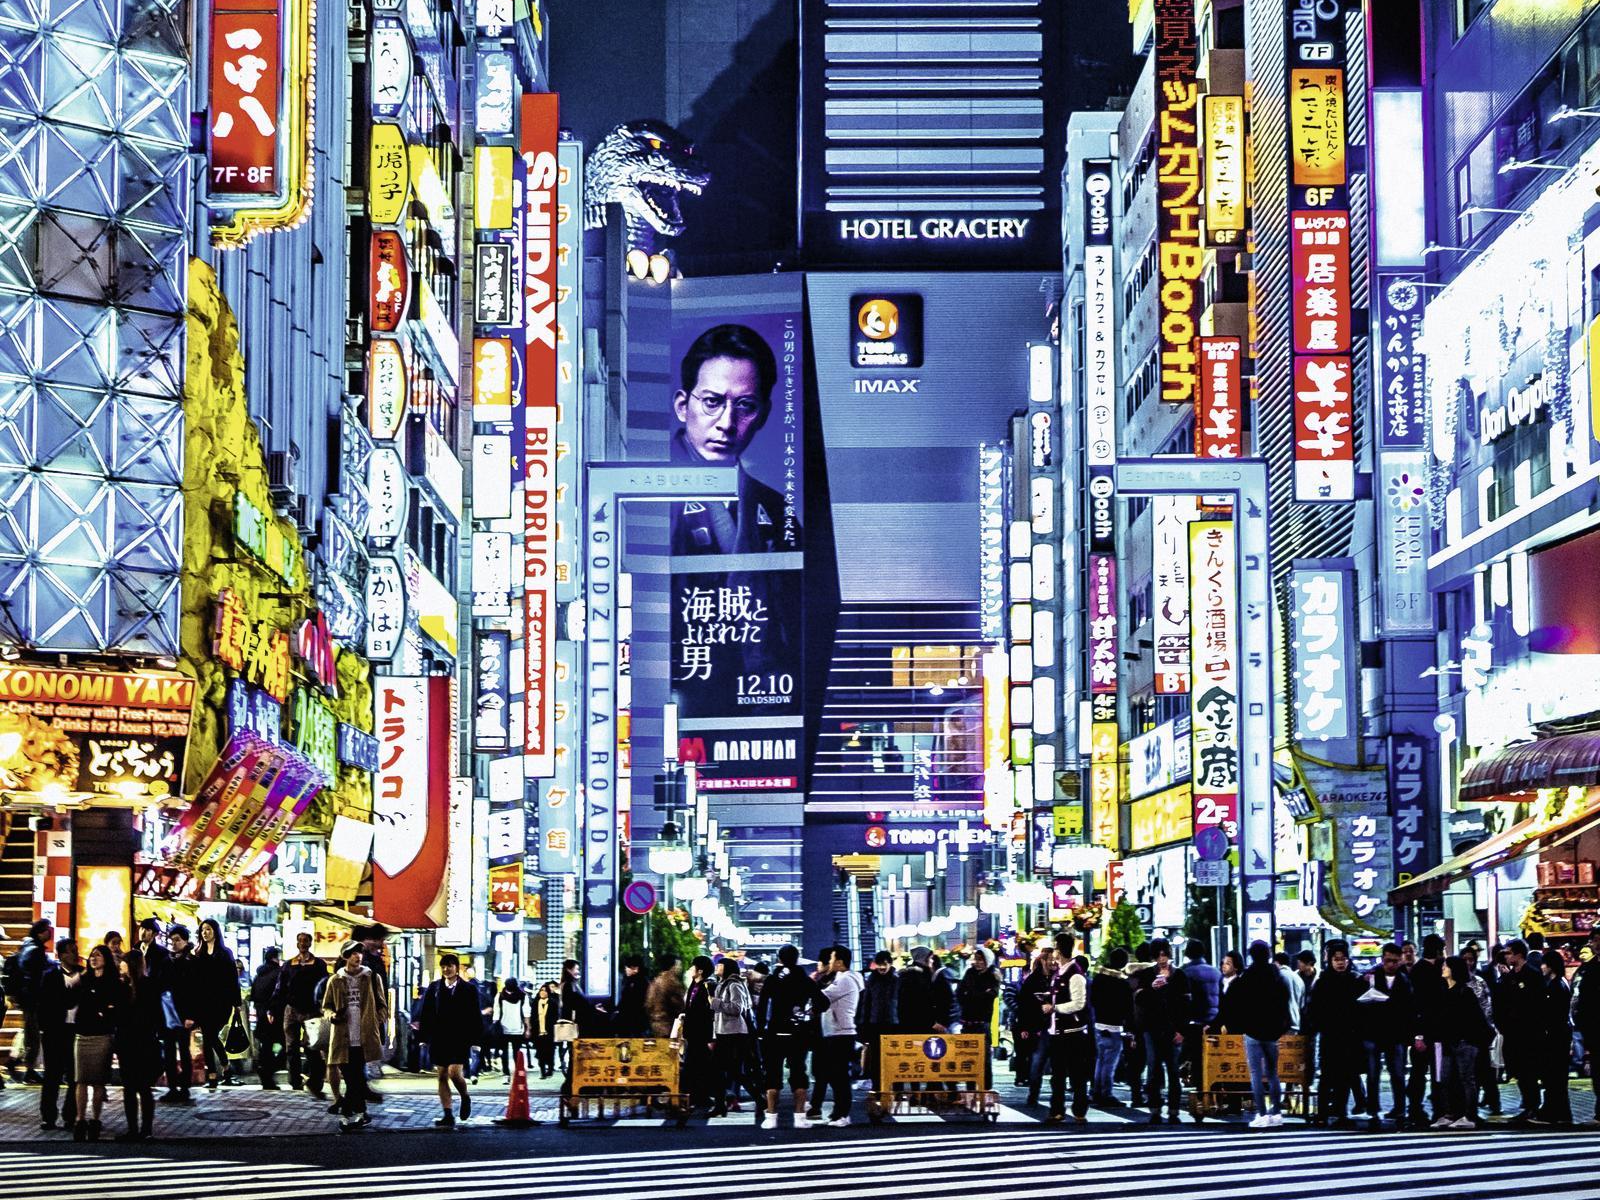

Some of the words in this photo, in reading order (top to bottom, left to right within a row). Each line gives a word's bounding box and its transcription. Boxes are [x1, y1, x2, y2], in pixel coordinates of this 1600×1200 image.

[1303, 46, 1330, 58] 7F
[1304, 187, 1336, 206] 6F
[841, 219, 917, 239] HOTEL
[920, 218, 1030, 239] GRACERY
[1214, 230, 1237, 243] 6F
[526, 151, 557, 350] SHIDAX
[525, 490, 548, 578] DRUG
[681, 585, 769, 623] 海賊と
[1205, 528, 1228, 652] きんくら酒場
[1396, 592, 1421, 610] 5F
[591, 527, 610, 726] GODZILLA
[681, 622, 762, 645] よばれた
[680, 645, 713, 681] 男
[1301, 575, 1343, 732] カラオケ
[124, 677, 193, 706] YAKI
[736, 673, 794, 696] 12.10
[737, 695, 792, 705] ROADSHOW
[1094, 694, 1116, 707] 4F
[1094, 707, 1116, 720] 3F
[381, 688, 405, 799] トラノコ
[713, 739, 796, 761] MARUHAN
[1196, 686, 1238, 788] 金の蔵
[591, 750, 610, 842] ROAD
[1396, 742, 1424, 866] カラオケ
[1195, 797, 1230, 825] 2F
[1351, 815, 1381, 917] カラオケ
